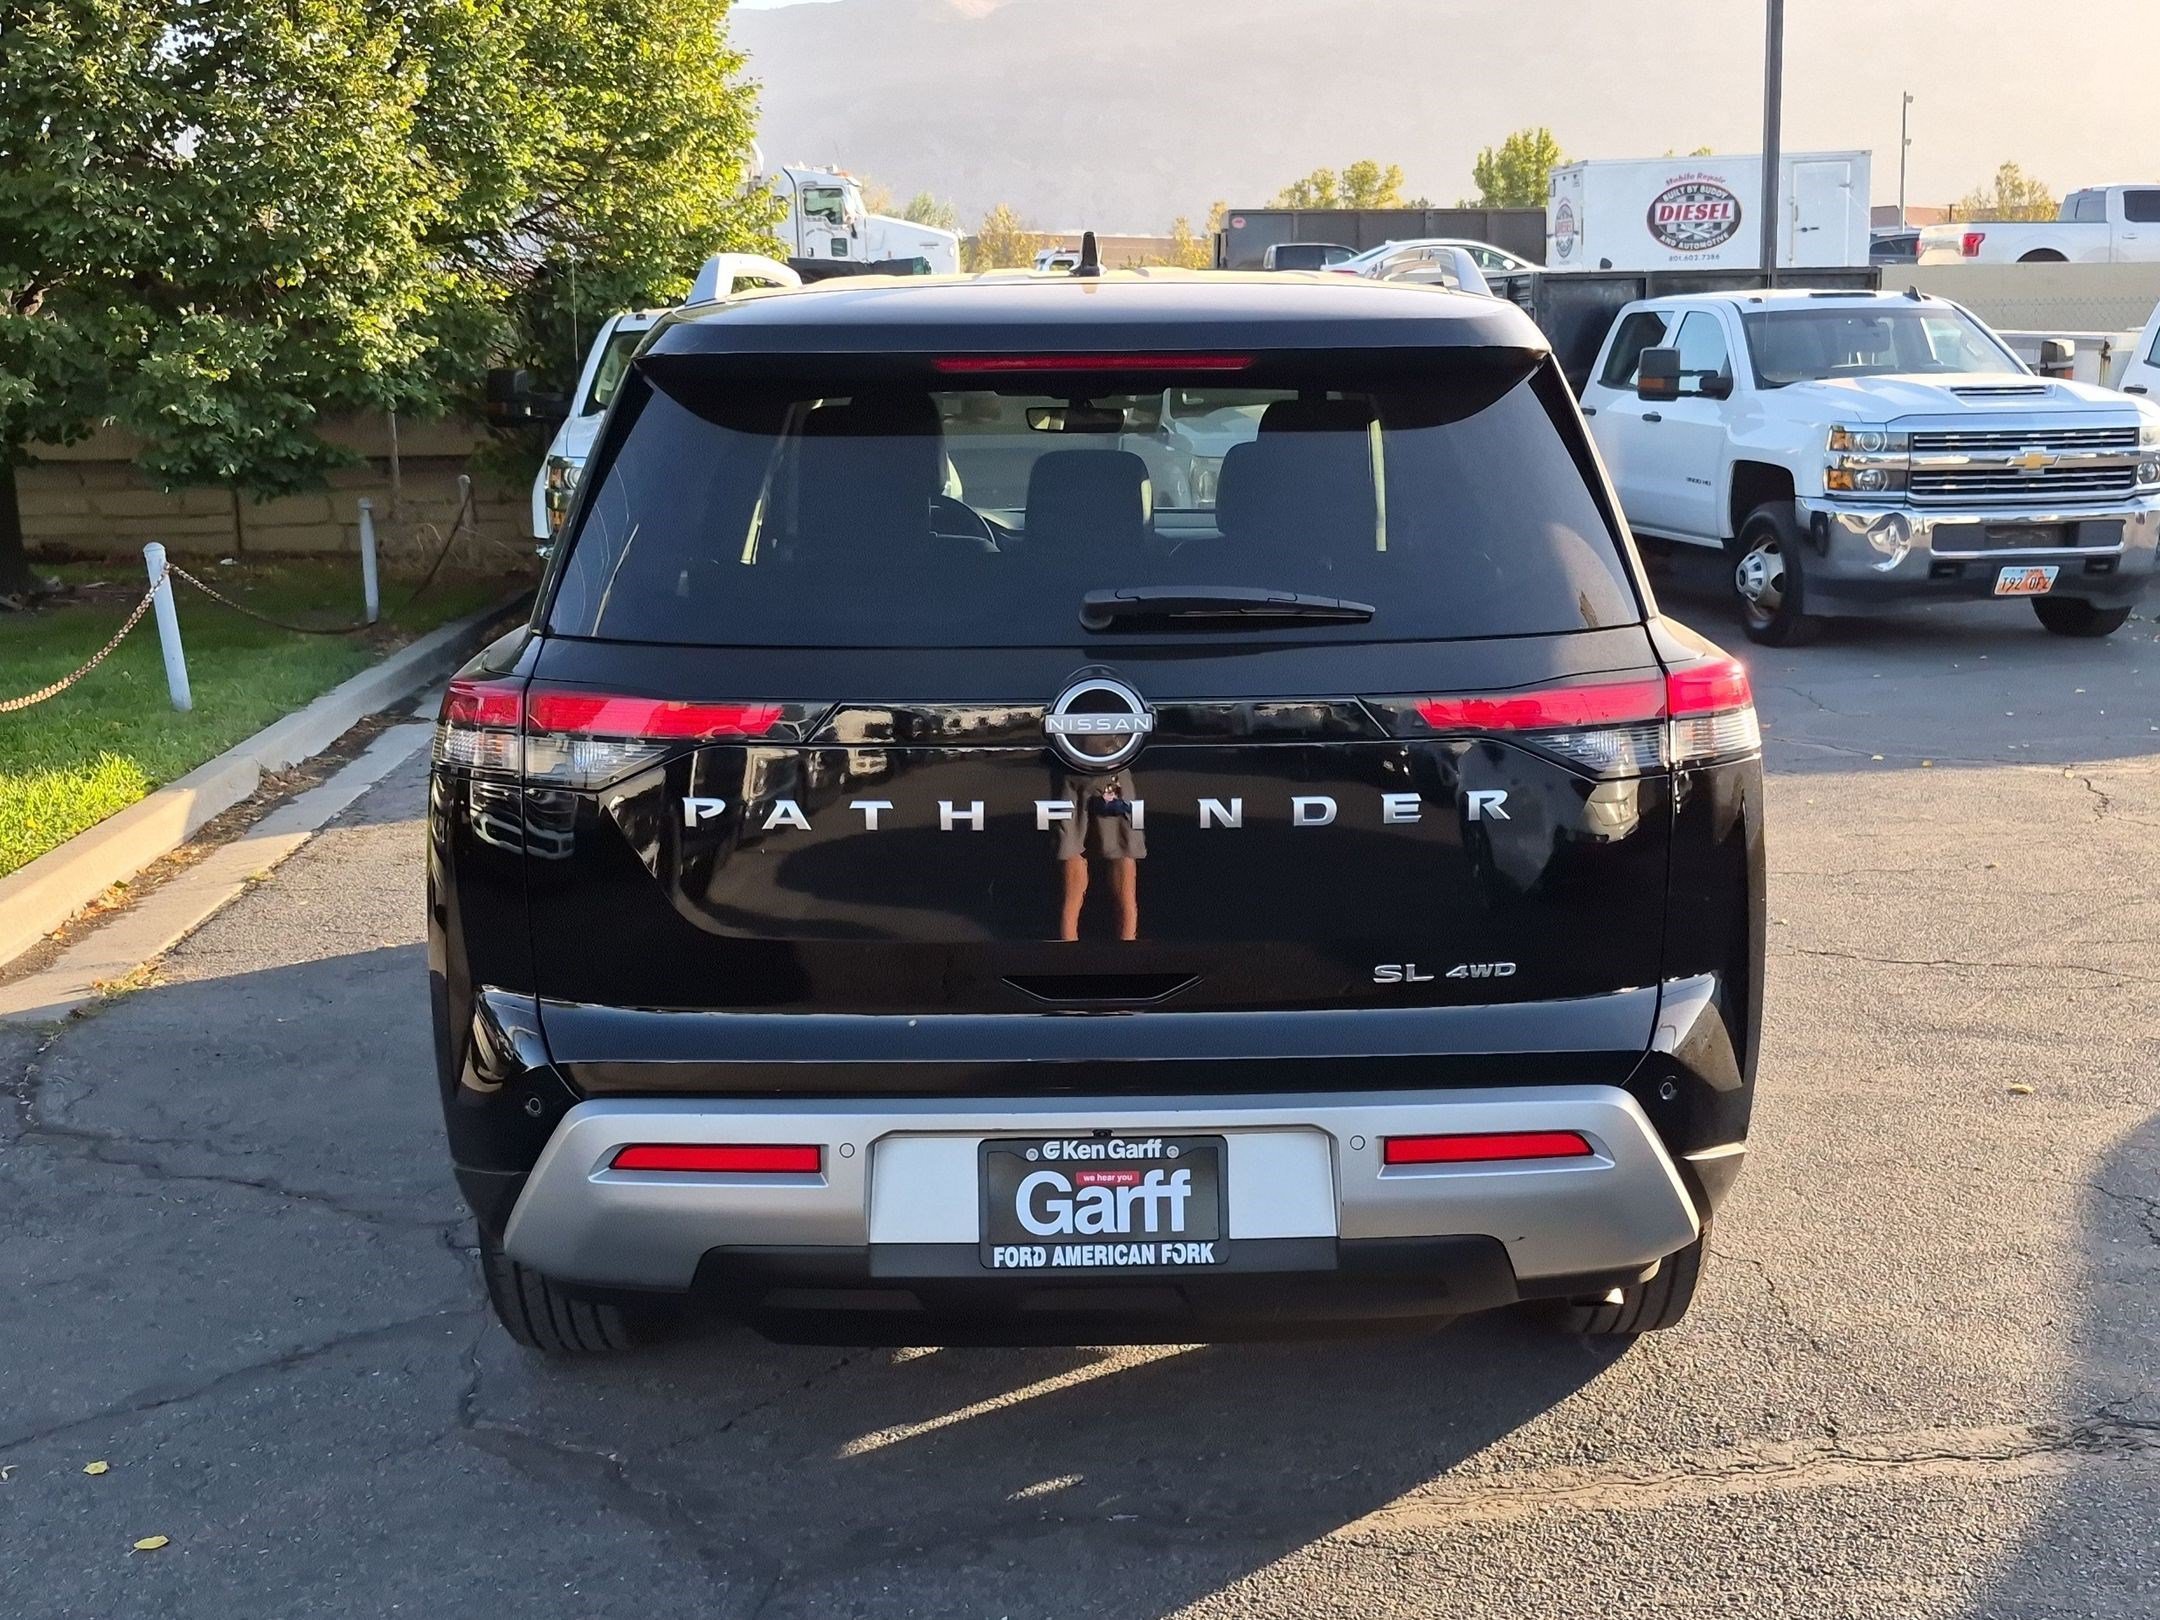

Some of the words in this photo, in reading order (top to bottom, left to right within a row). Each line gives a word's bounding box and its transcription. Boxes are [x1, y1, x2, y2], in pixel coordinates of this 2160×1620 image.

[1665, 172, 1695, 185] Mobile
[1696, 171, 1726, 184] Repair
[1662, 186, 1685, 202] BUILT
[1686, 185, 1699, 194] BY
[1699, 185, 1729, 200] BUDDY
[1658, 203, 1731, 222] DIESEL
[1660, 234, 1678, 247] AND
[1678, 231, 1730, 250] AUTOMOTIVE
[1049, 717, 1149, 731] NISSAN
[682, 789, 1511, 831] PATHFINDER
[1373, 963, 1435, 984] SL
[1445, 962, 1517, 979] 4WD
[1063, 1140, 1105, 1159] Ken
[1108, 1139, 1162, 1159] Garff
[1096, 1173, 1115, 1181] hear
[1117, 1174, 1133, 1183] you
[1015, 1168, 1192, 1236] Garff
[993, 1246, 1047, 1268] FORD
[1051, 1244, 1156, 1266] AMERICAN
[1161, 1242, 1215, 1265] FORK
